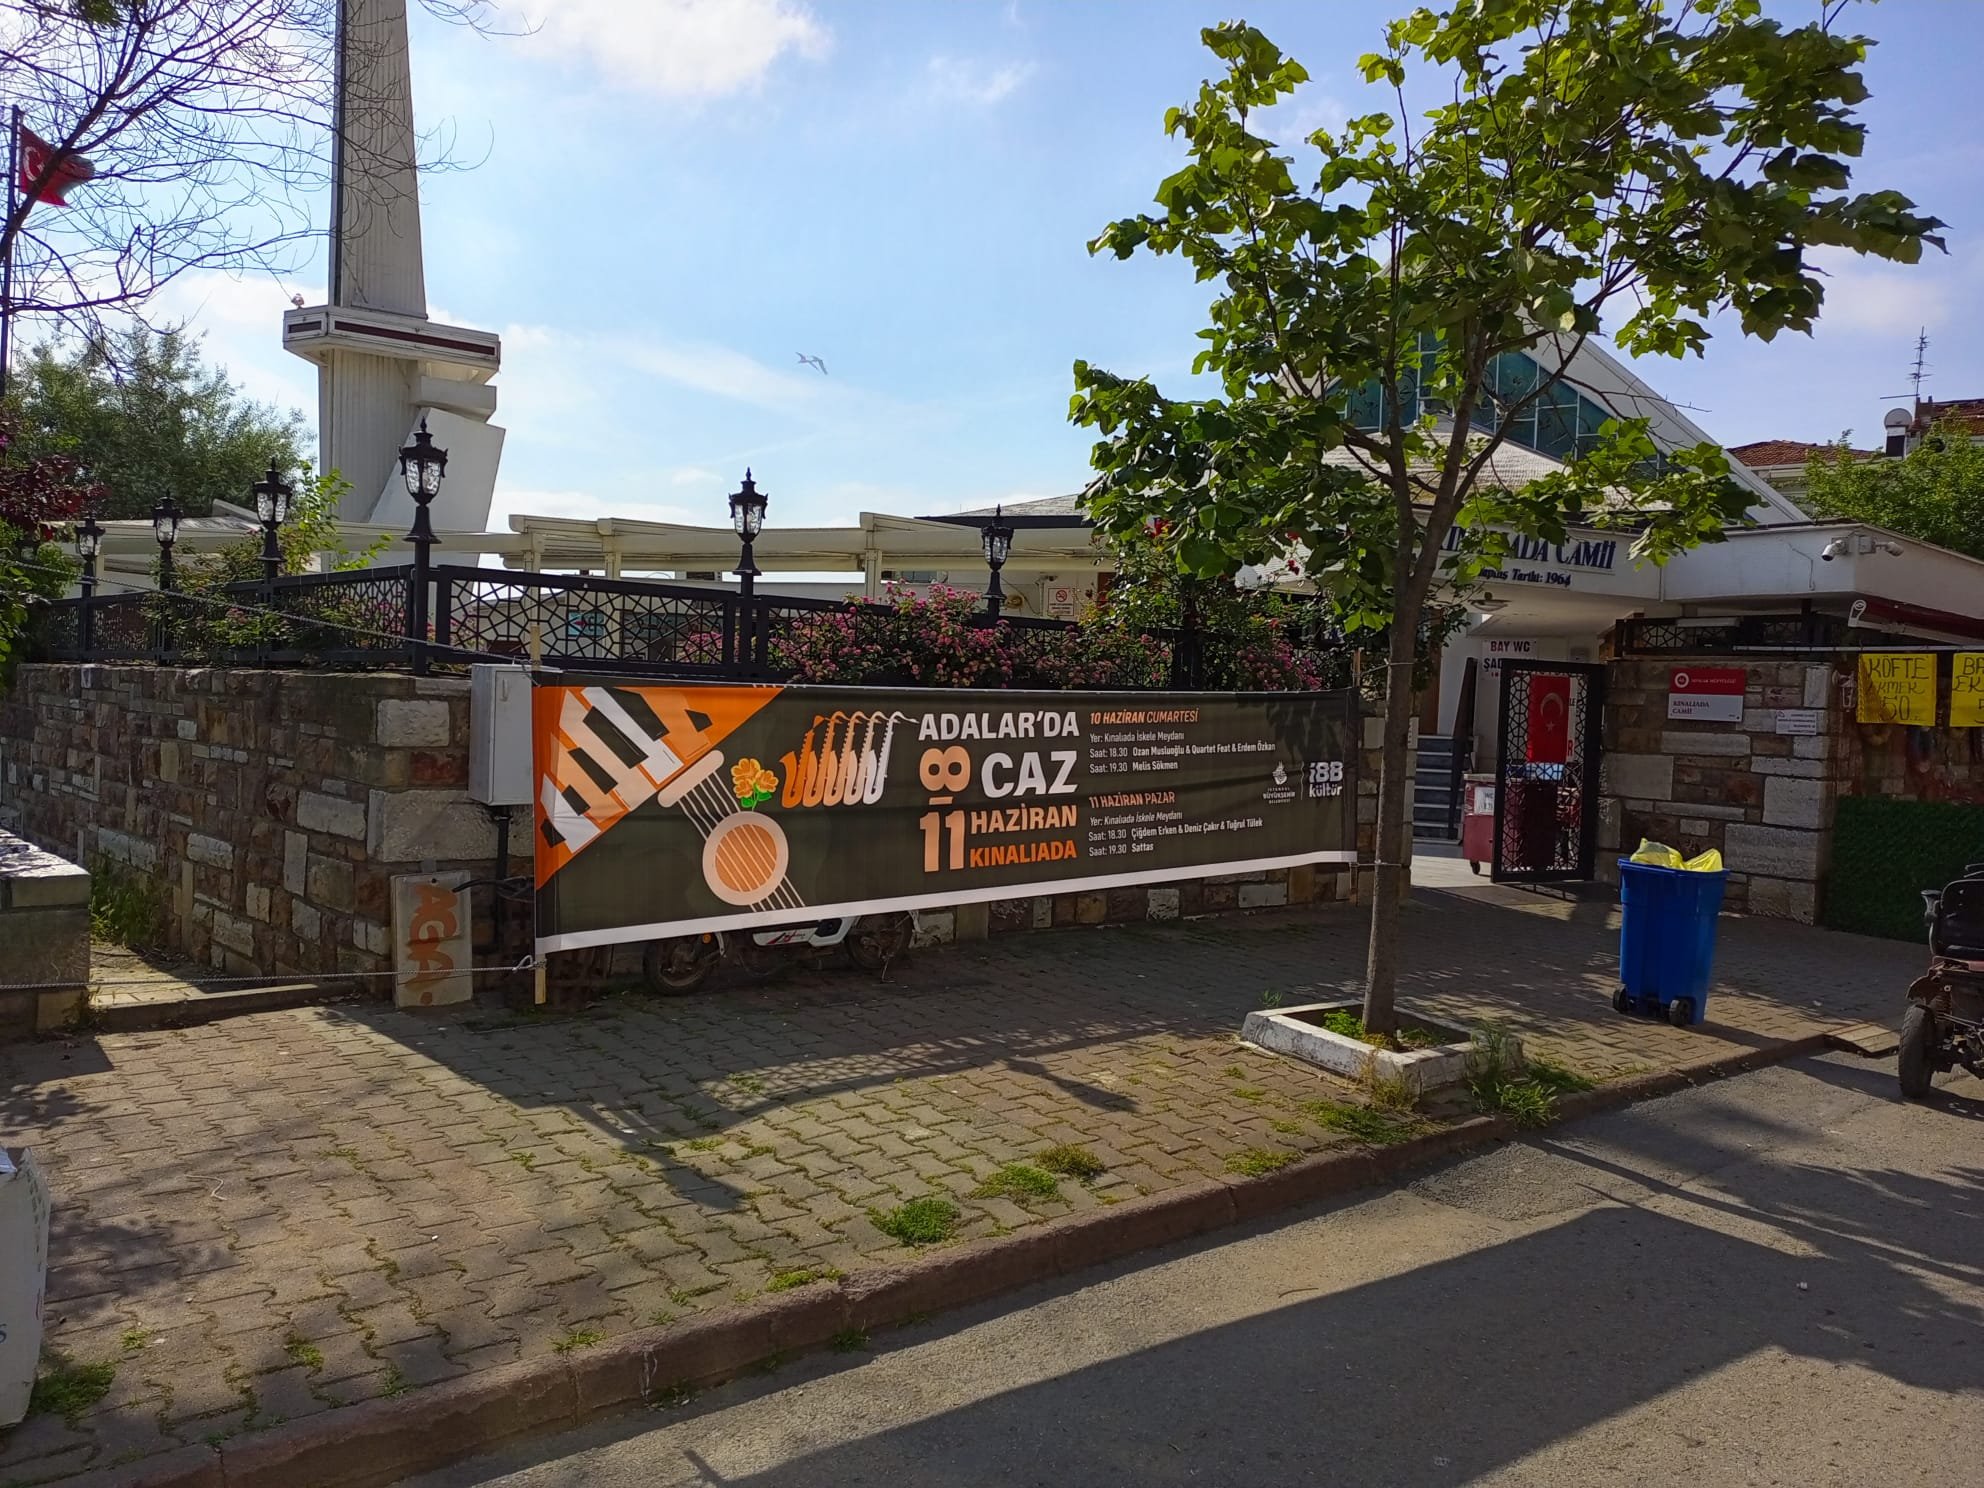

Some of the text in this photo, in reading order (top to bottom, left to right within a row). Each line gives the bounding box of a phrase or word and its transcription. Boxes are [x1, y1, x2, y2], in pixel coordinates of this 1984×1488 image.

[1545, 571, 1572, 587] 1964
[1490, 640, 1530, 652] BAY WC
[1090, 708, 1199, 725] 10 HAZİRAN CUMARTESİ
[1090, 732, 1103, 743] Yer:
[1157, 730, 1185, 742] Meydanı
[1089, 748, 1108, 758] Saat:
[1109, 747, 1128, 757] 18.30
[1191, 744, 1216, 755] Quartet
[1216, 743, 1231, 753] Feat
[1237, 742, 1257, 752] Erdem
[1257, 740, 1276, 751] Özkan
[919, 745, 971, 792] 8
[981, 750, 1078, 799] CAZ
[1089, 760, 1178, 774] Saat: 19.30 Melis Sökmen
[1309, 783, 1343, 797] kültür
[1088, 791, 1175, 808] 11 HAZİRAN PAZAR
[970, 803, 1077, 834] HAZİRAN
[1090, 816, 1103, 827] Yer:
[1088, 831, 1107, 842] Saat:
[1108, 829, 1127, 840] 18.30
[1184, 822, 1203, 833] Deniz
[1246, 817, 1263, 828] Tülek
[919, 810, 965, 872] 11
[970, 840, 1077, 868] KINALIADA
[1088, 847, 1108, 857] Saat:
[1108, 844, 1127, 855] 19.30
